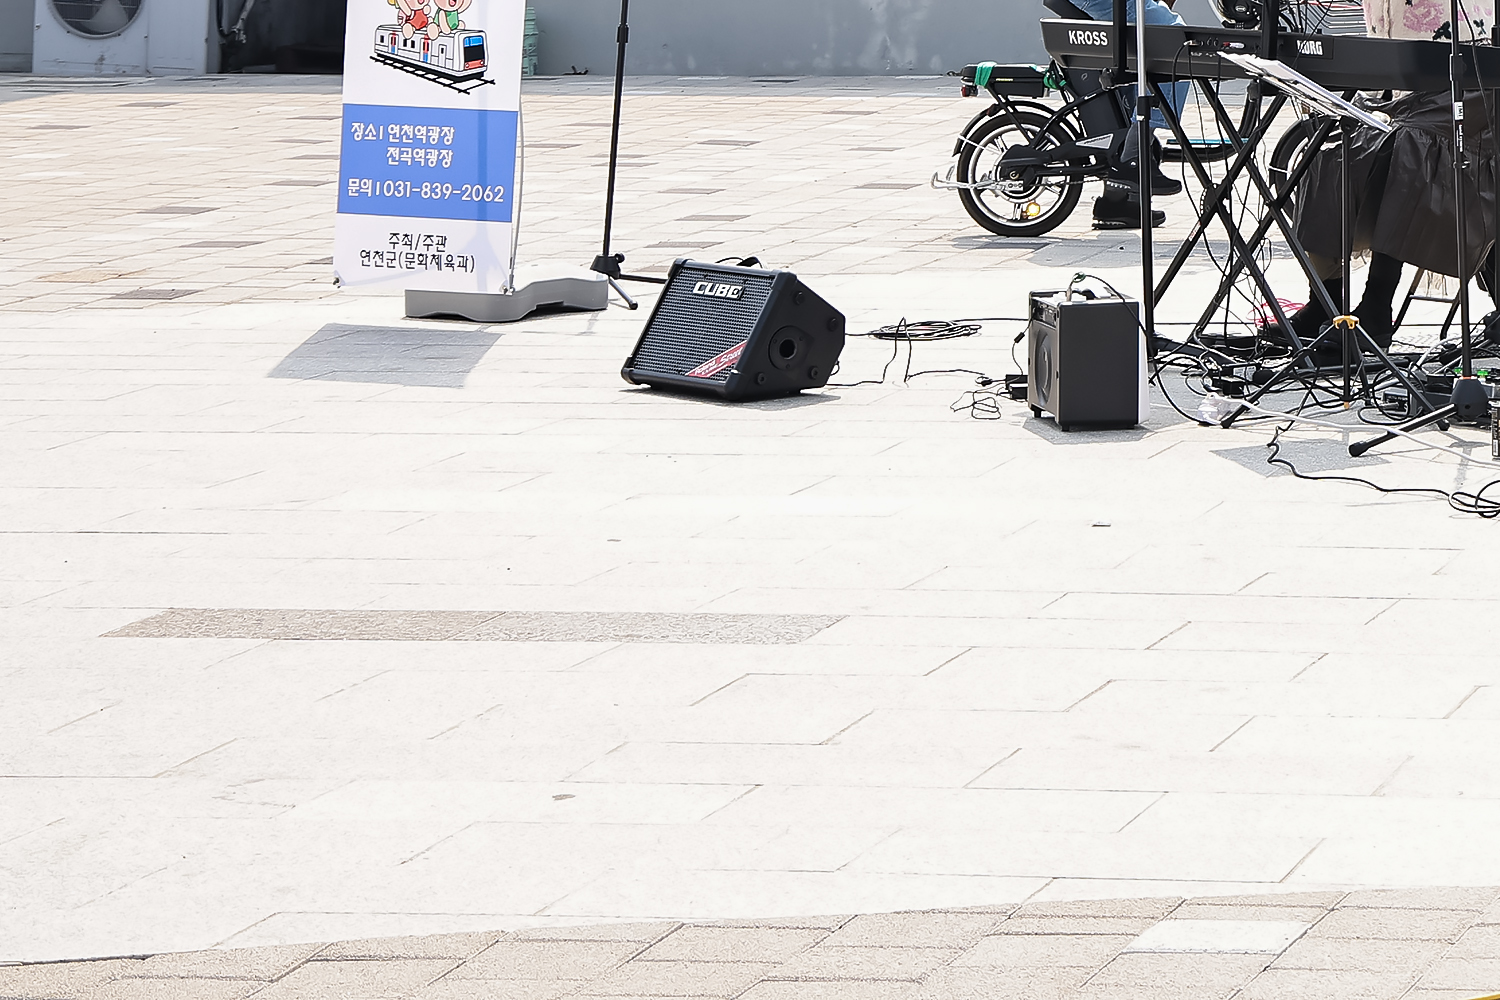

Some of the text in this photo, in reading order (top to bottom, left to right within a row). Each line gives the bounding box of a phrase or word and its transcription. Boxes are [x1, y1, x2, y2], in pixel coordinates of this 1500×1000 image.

[1068, 30, 1108, 46] KROSS
[1296, 39, 1323, 56] KORG
[387, 123, 455, 145] 연천역광장
[386, 146, 454, 168] 전곡역광장
[383, 180, 505, 202] 031-839-2062
[389, 232, 448, 252] 주최/주관
[359, 249, 475, 273] 연천군(문화체육과)
